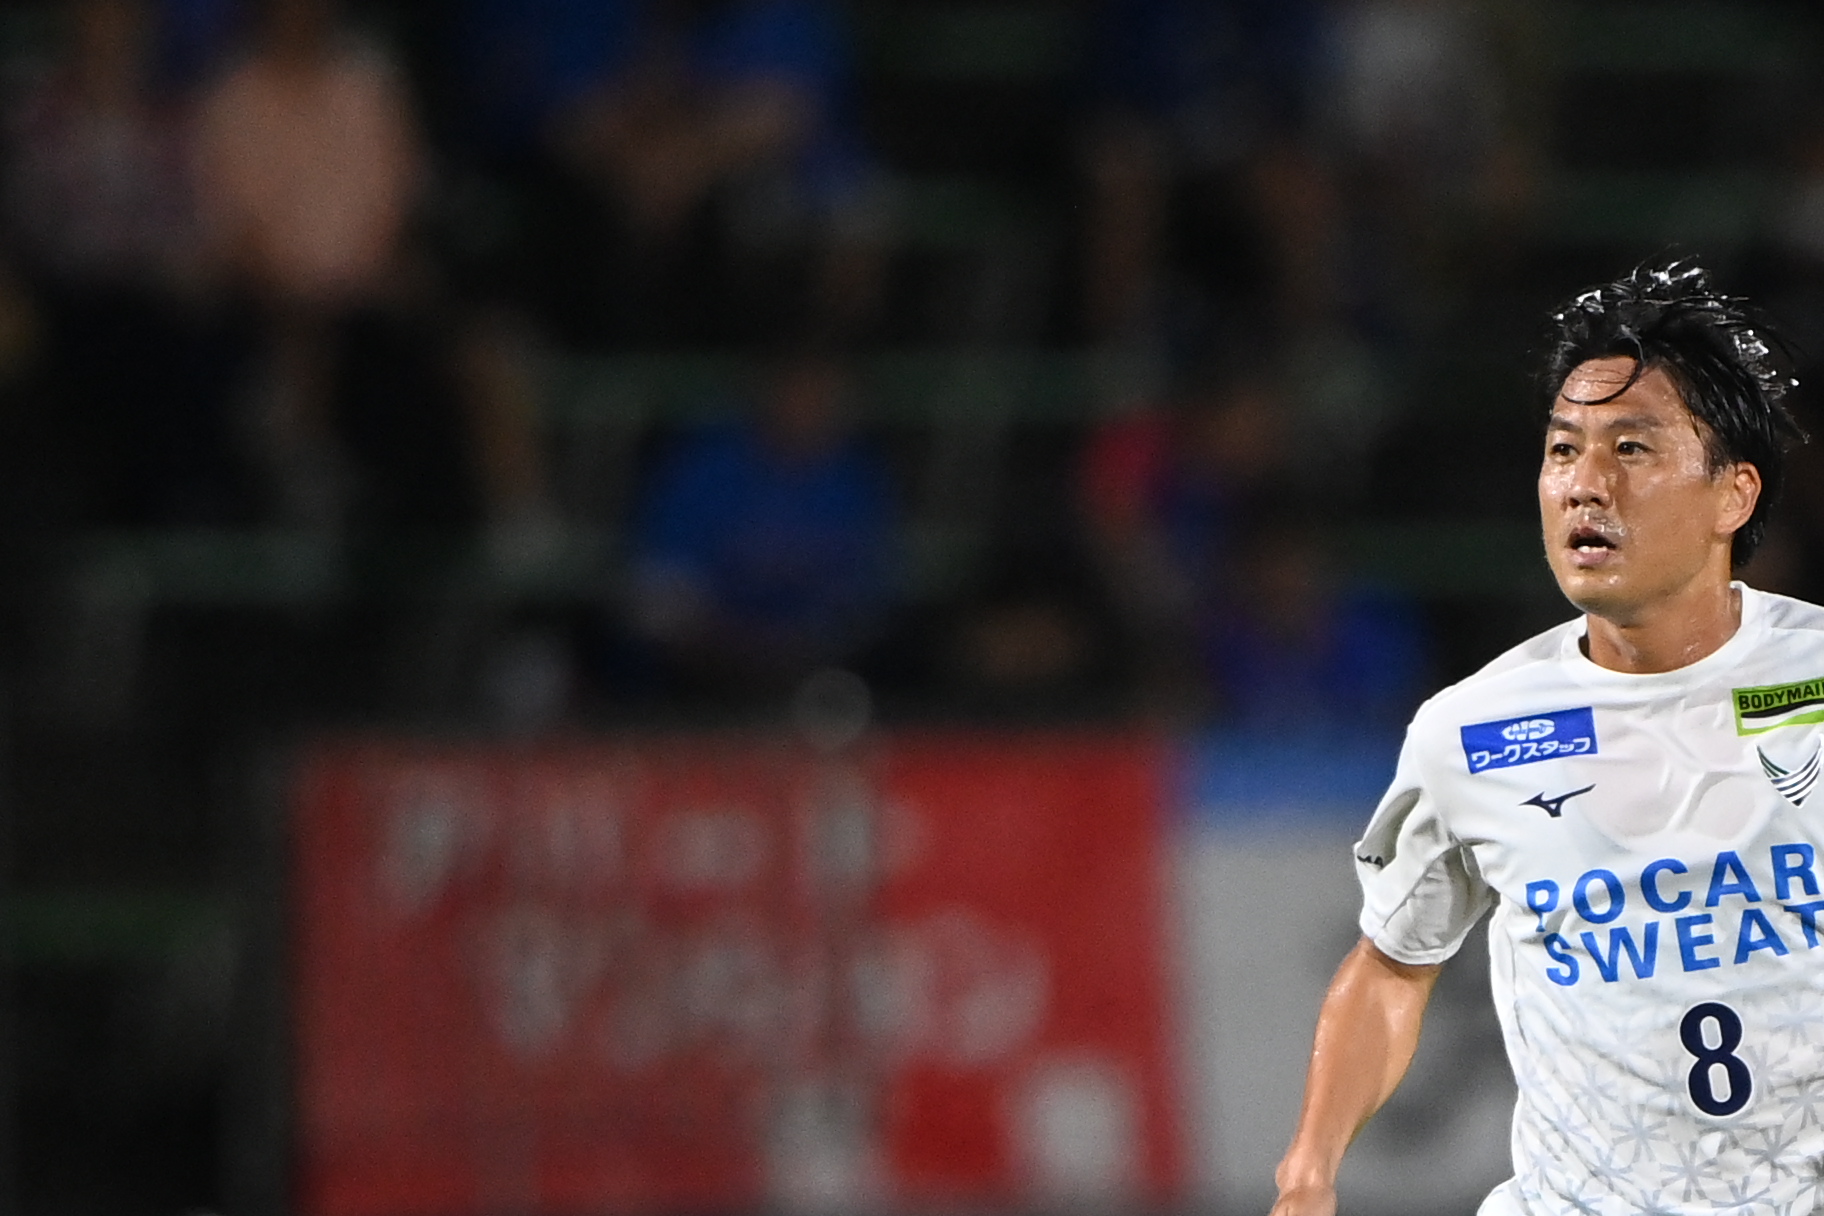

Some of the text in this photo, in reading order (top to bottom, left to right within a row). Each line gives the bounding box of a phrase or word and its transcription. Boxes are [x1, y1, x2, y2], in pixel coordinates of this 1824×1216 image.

[1470, 736, 1591, 769] ワークスタッフ
[1680, 1002, 1752, 1117] 8
